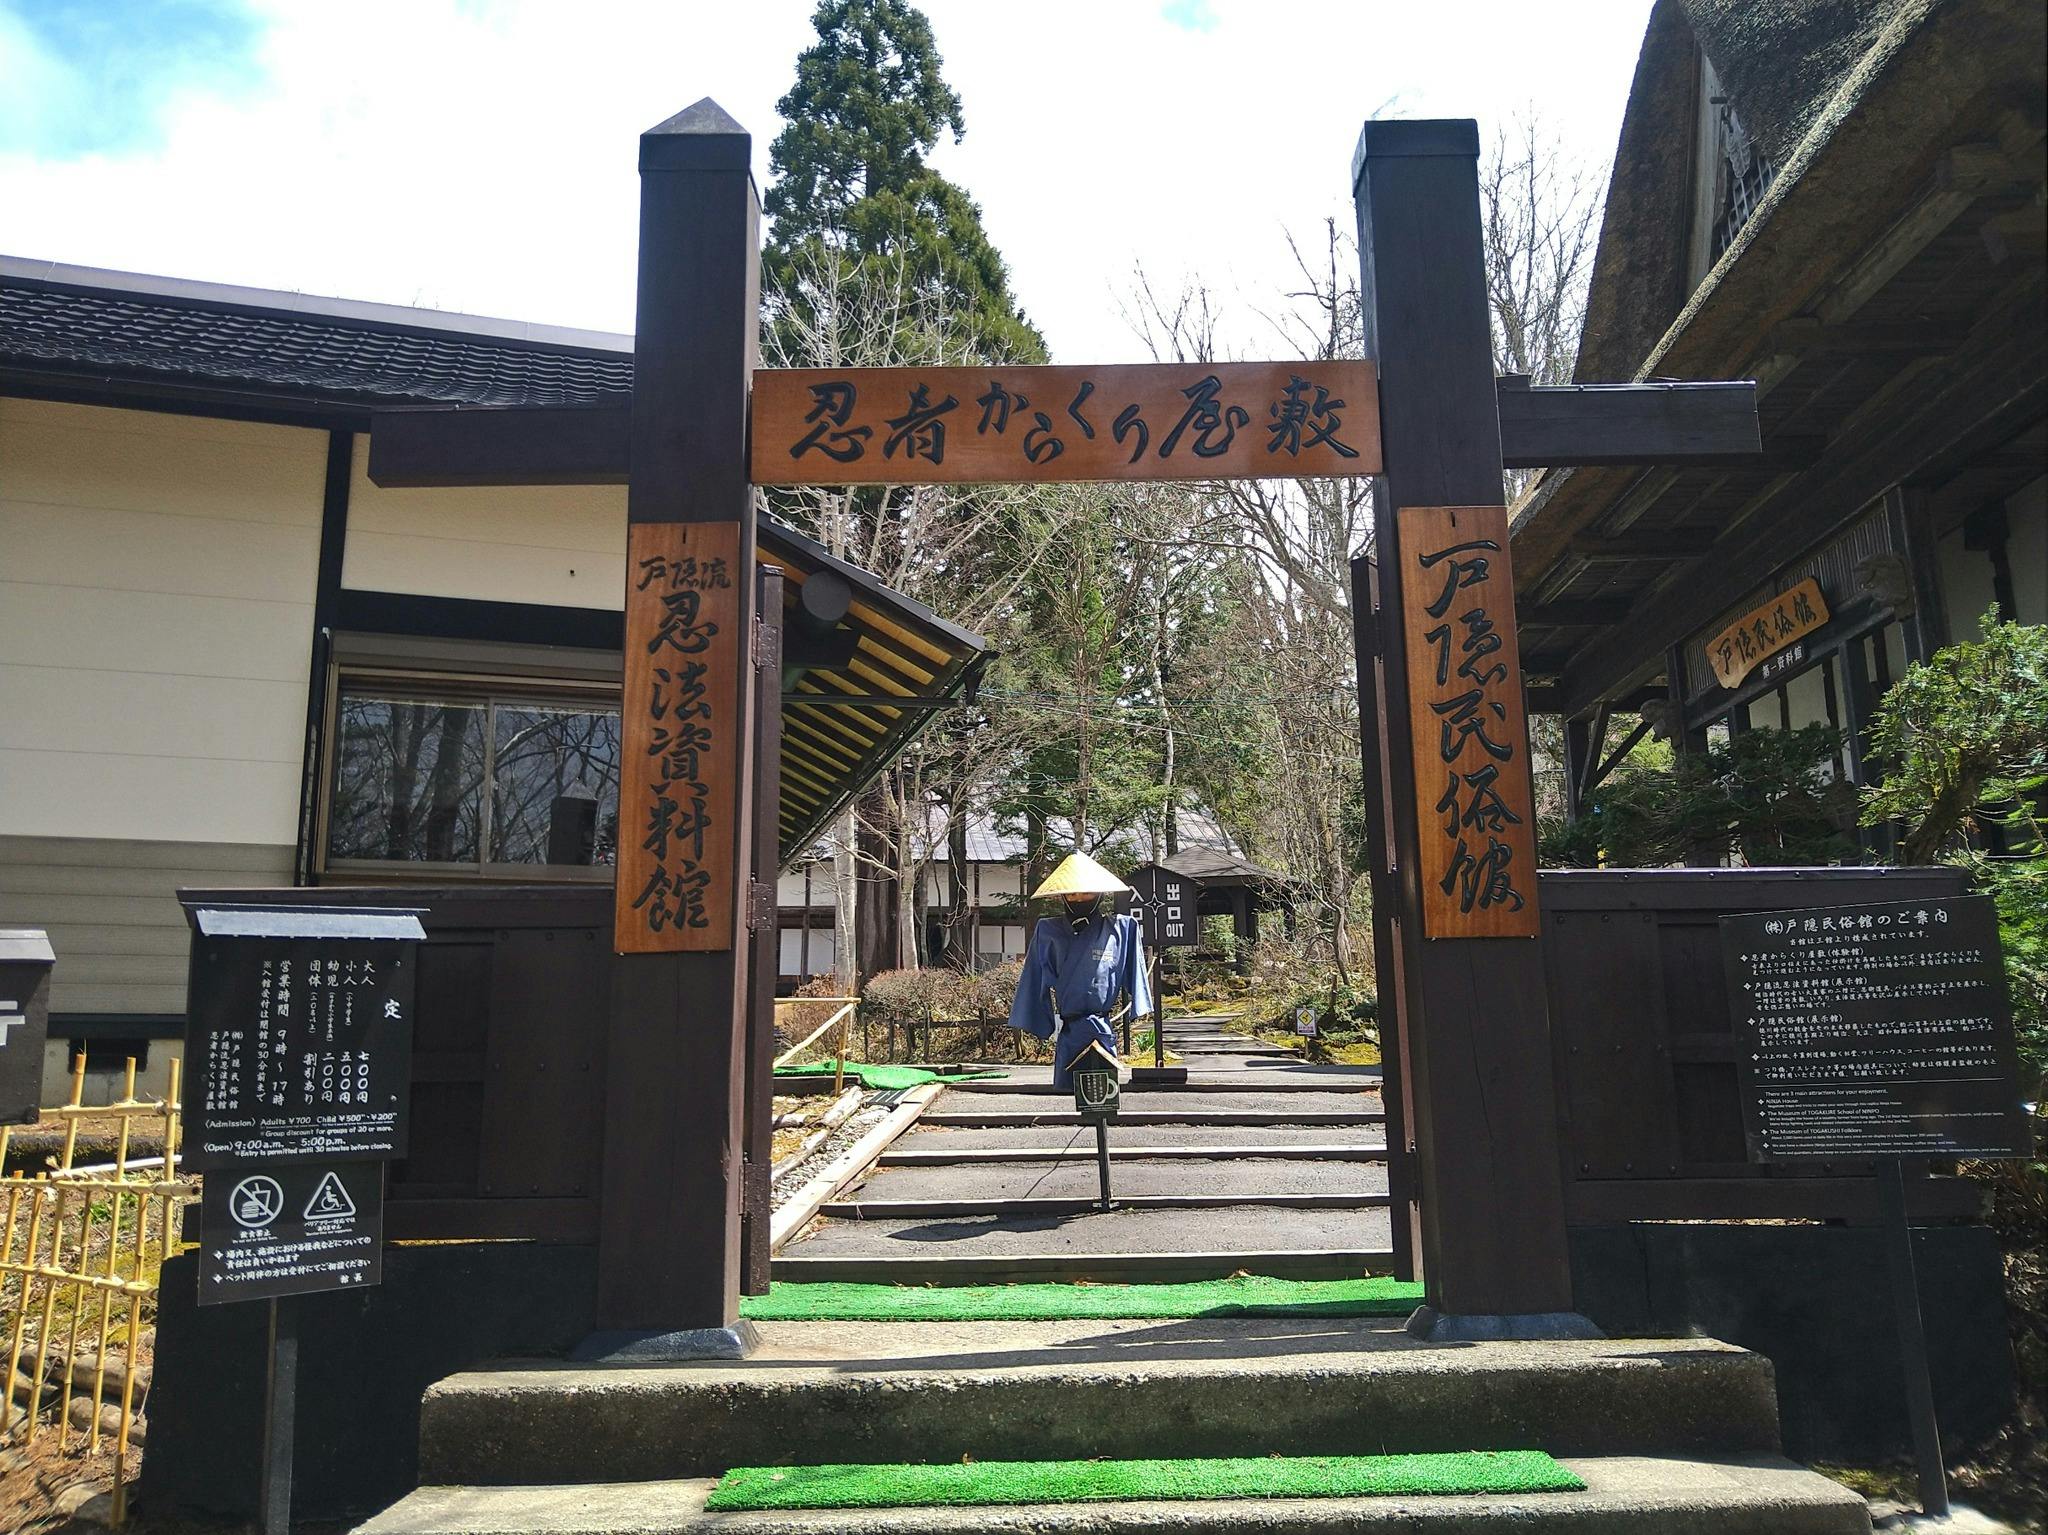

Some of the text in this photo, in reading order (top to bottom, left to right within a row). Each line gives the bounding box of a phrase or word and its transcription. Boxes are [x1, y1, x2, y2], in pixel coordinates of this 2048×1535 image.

[789, 375, 1359, 465] 忍者からくり屋敷
[637, 556, 731, 592] 戸隠流
[1419, 539, 1524, 914] 戸隠民俗館
[632, 590, 719, 932] 忍法資料館
[1167, 884, 1181, 920] 出口
[1166, 924, 1184, 937] OUT
[278, 960, 292, 1017] 営業時間
[308, 959, 322, 987] 団体
[327, 960, 340, 987] 幼児
[344, 960, 357, 985] 小人
[361, 960, 376, 985] 大人
[302, 1052, 317, 1105] 割引あり
[260, 1118, 286, 1126] Adults
[316, 1115, 337, 1123] Child
[267, 1147, 297, 1156] permitted
[350, 1144, 370, 1152] before
